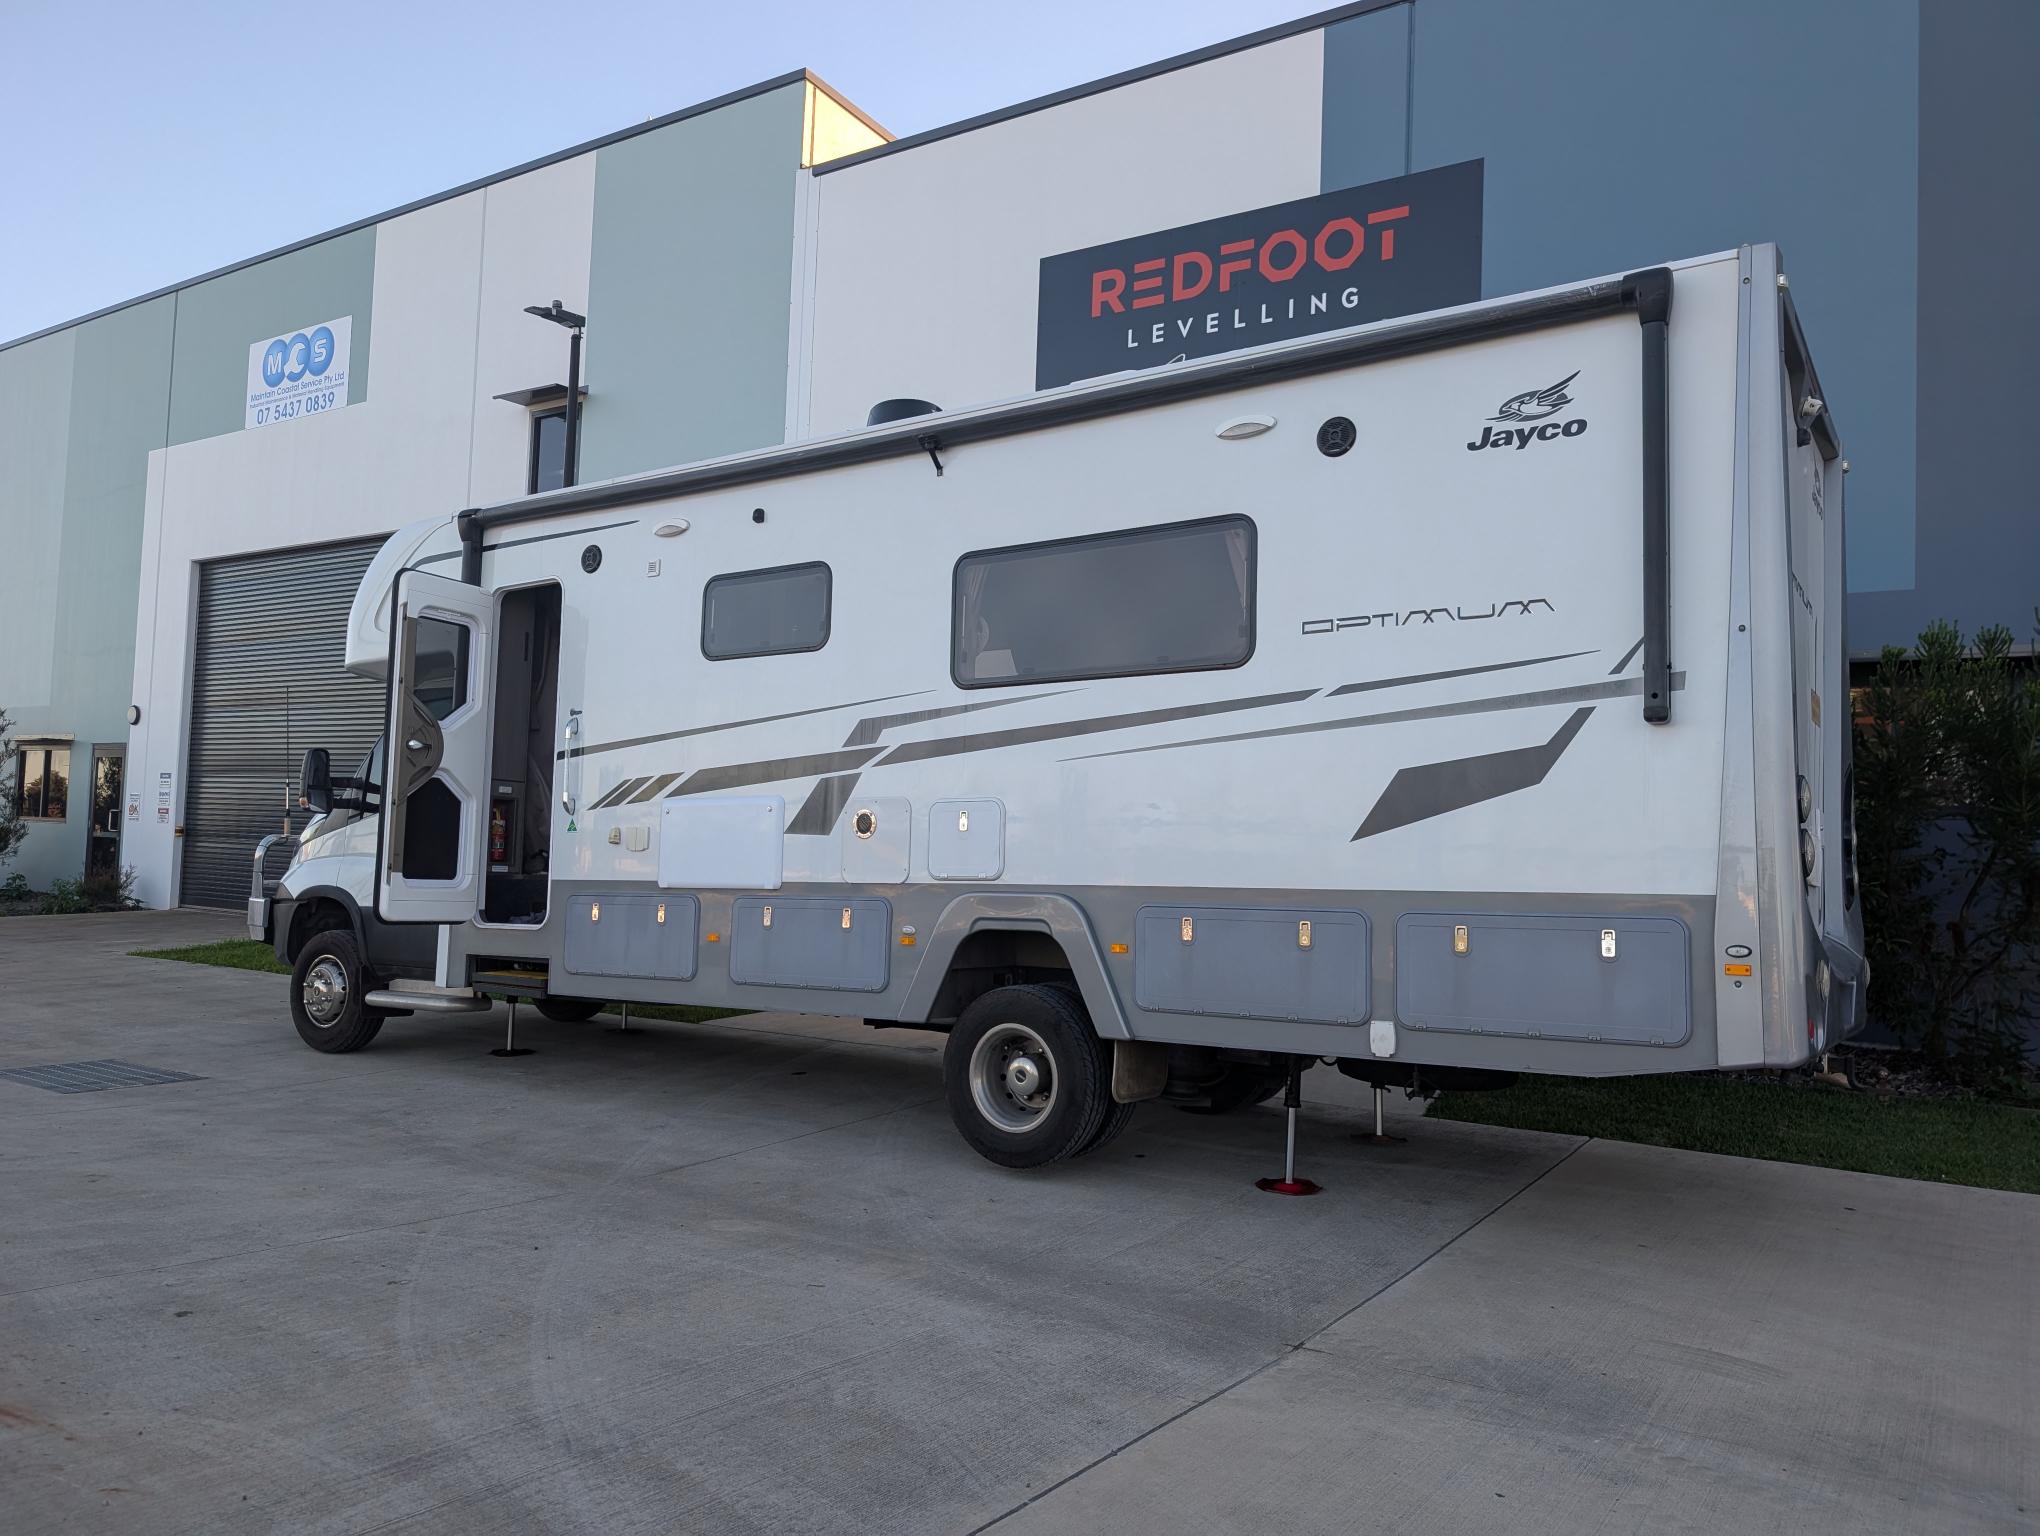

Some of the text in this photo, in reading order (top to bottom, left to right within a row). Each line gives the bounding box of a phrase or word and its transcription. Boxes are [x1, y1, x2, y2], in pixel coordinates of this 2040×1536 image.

[1091, 206, 1409, 317] REDFOOT
[1127, 287, 1359, 347] LEVELLING
[251, 370, 344, 402] Maintain Coastal Service Pty Ltd
[257, 391, 335, 425] 07 5437 0839
[1467, 419, 1588, 451] Jayco
[1302, 598, 1556, 634] OPTIMUM
